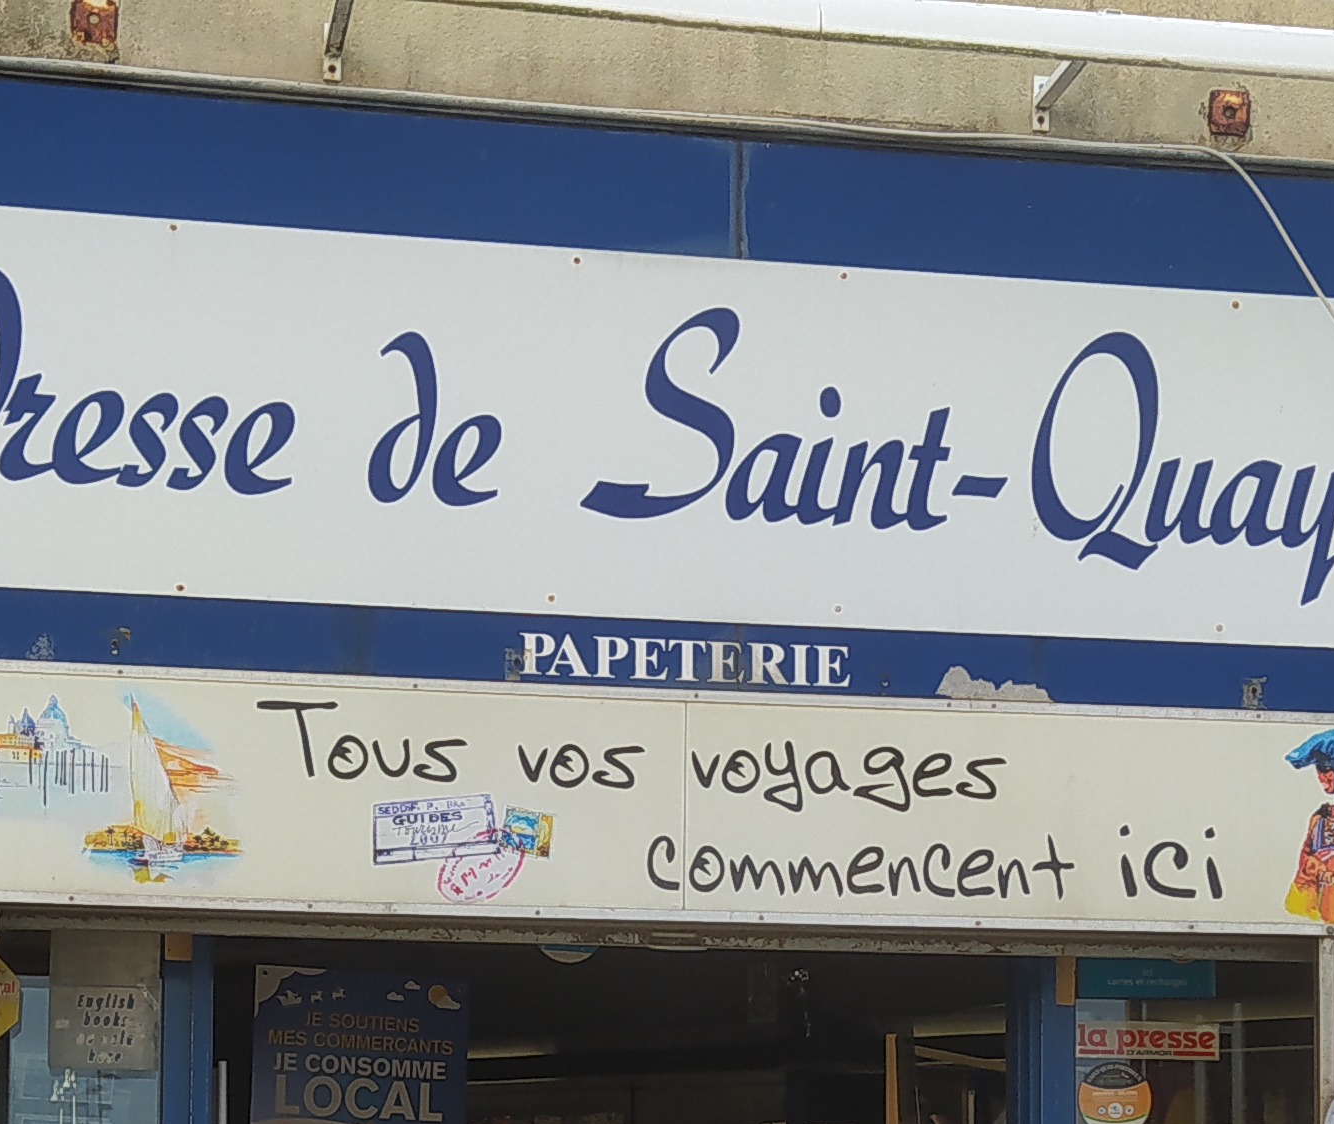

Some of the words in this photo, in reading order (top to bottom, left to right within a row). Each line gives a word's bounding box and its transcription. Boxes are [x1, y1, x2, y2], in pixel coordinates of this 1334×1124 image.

[368, 331, 501, 507] de
[520, 631, 851, 689] PAPETERIE
[257, 700, 468, 783] Tous
[518, 743, 646, 789] vos
[692, 741, 1008, 812] voyages
[393, 811, 462, 825] GUIDES
[1119, 825, 1224, 900] ici
[77, 993, 135, 1011] English
[305, 1012, 322, 1026] JE
[329, 1013, 420, 1033] SOUTIENS
[268, 1029, 307, 1046] MES
[314, 1032, 453, 1056] COMMERÇANTS
[1078, 1024, 1108, 1047] la
[1116, 1029, 1216, 1056] presse
[273, 1052, 297, 1071] JE
[305, 1054, 447, 1080] CONSOMME
[275, 1074, 443, 1122] LOCAL
